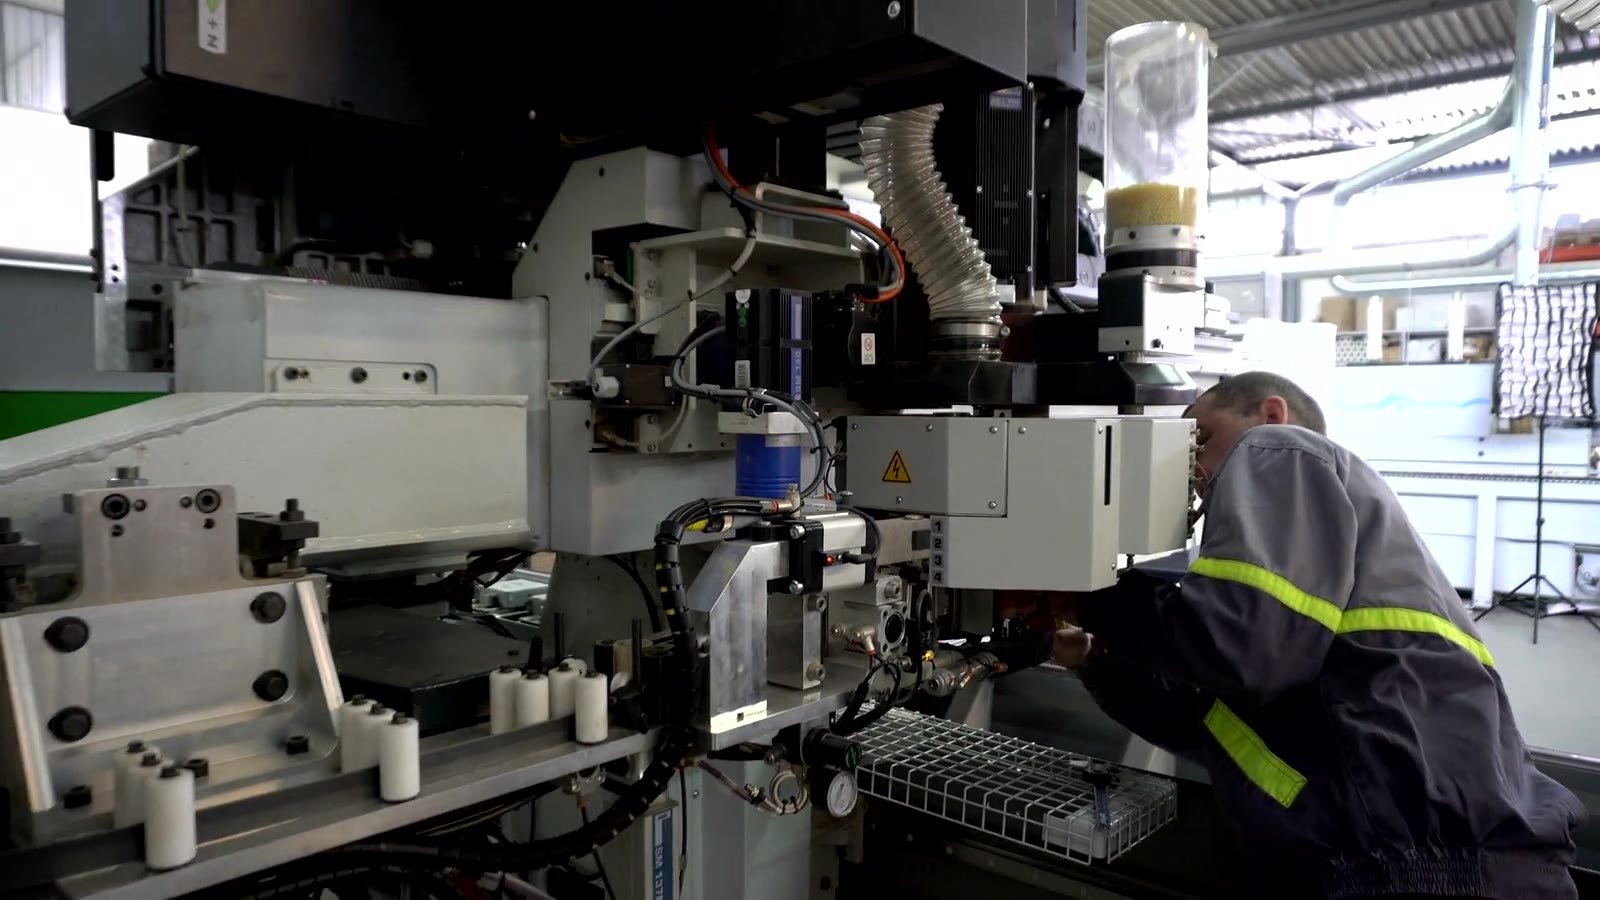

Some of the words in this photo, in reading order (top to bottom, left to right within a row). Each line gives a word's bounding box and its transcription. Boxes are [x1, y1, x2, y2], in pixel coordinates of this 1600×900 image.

[935, 521, 941, 532] 1
[934, 538, 942, 549] 2
[934, 555, 942, 566] 3
[934, 572, 942, 583] 4
